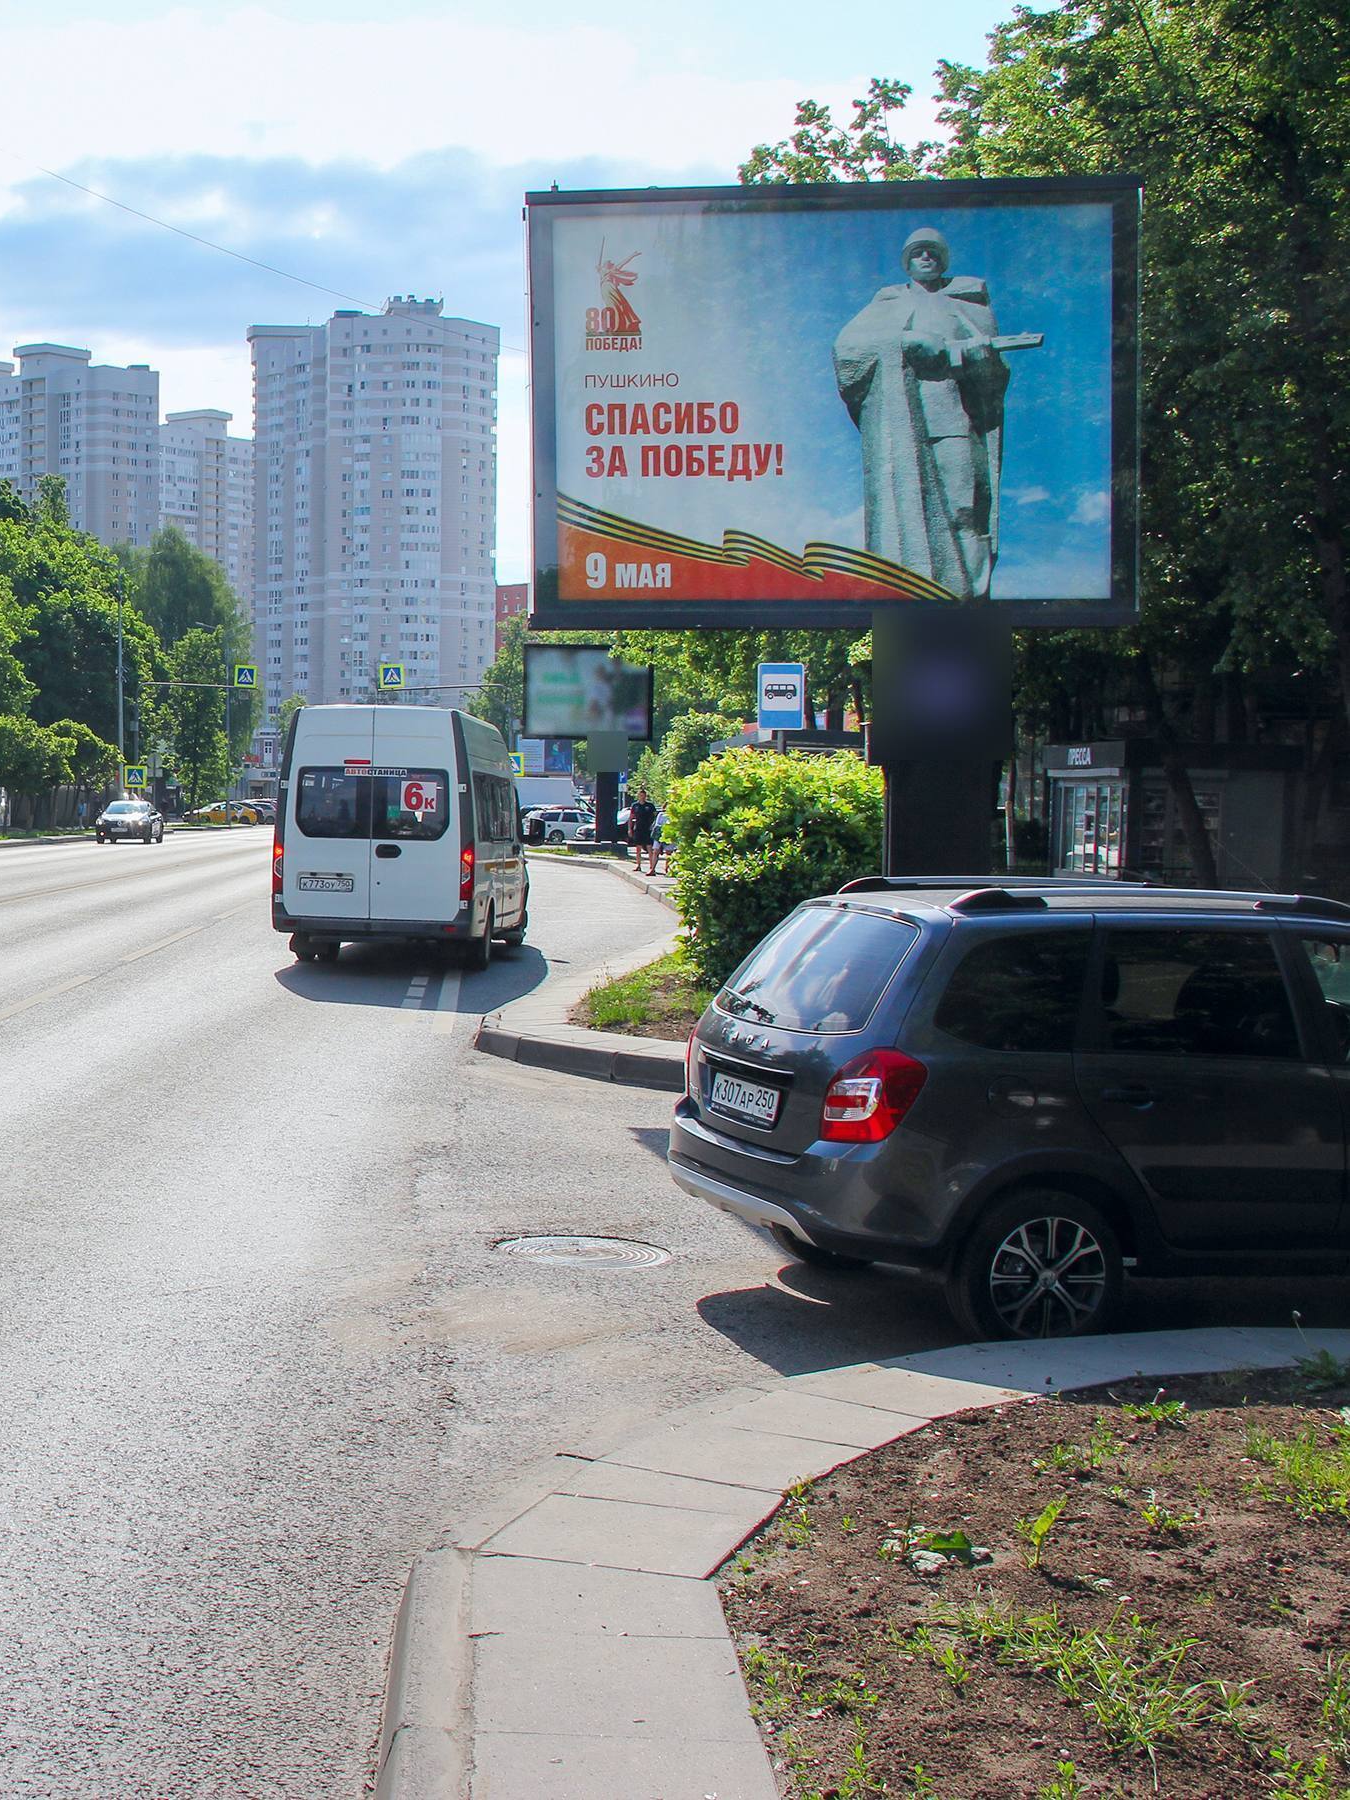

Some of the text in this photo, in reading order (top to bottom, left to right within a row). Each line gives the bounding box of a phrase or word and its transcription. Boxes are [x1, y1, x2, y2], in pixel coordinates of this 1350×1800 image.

[585, 306, 616, 332] 80
[585, 337, 642, 353] ПОБЕДА!
[584, 372, 679, 388] ПУШКИНО
[585, 401, 740, 436] СПАСИБО
[585, 443, 784, 482] ЗА ПОБЕДУ!
[585, 552, 671, 589] 9 МАЯ
[1067, 747, 1091, 766] ПРЕССА
